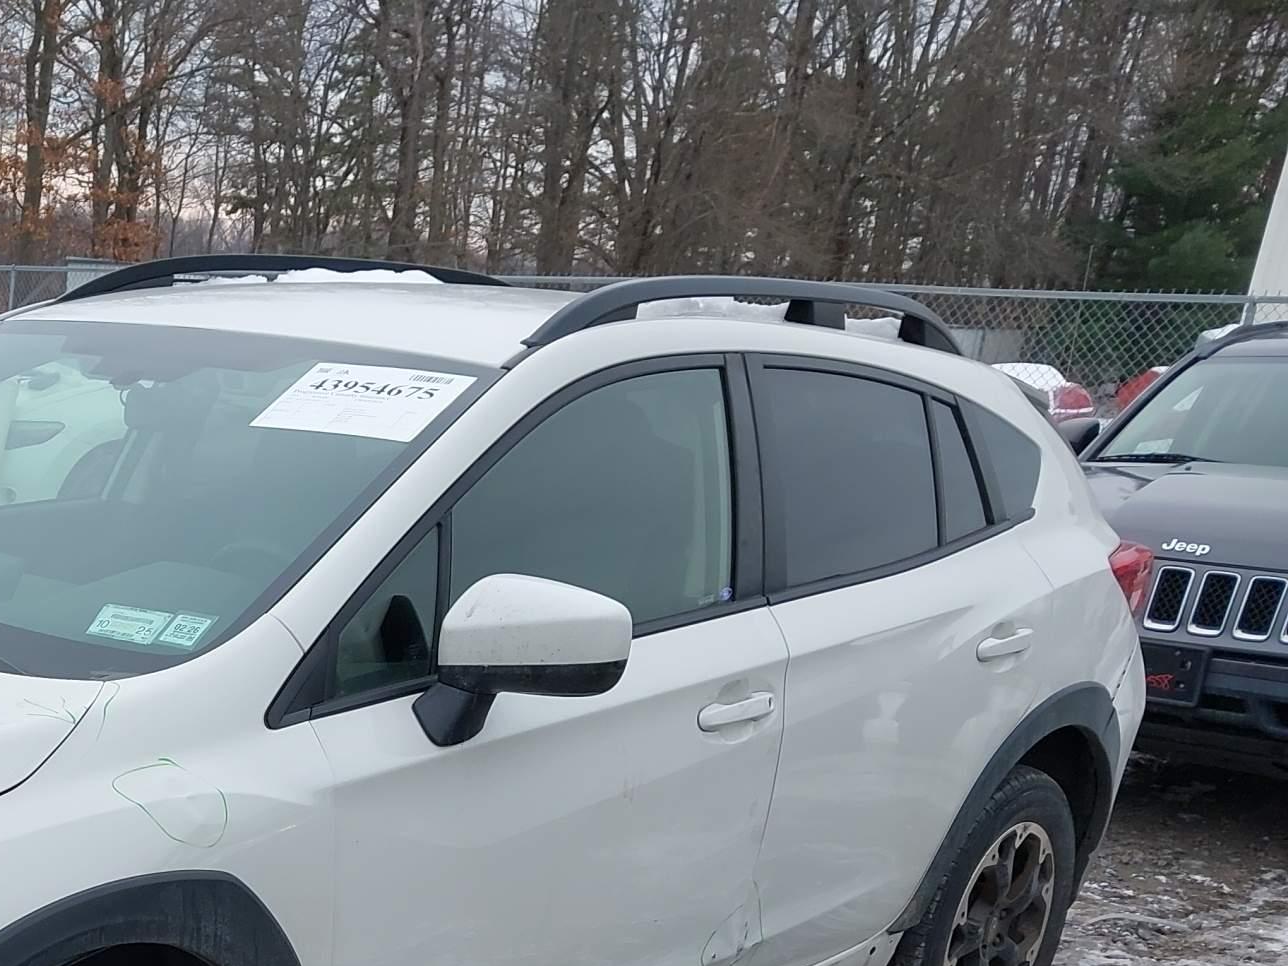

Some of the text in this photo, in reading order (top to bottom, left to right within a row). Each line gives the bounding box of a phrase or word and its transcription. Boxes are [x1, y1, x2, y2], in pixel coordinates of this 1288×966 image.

[309, 378, 440, 400] 43954675
[1162, 538, 1211, 556] Jeep
[96, 619, 111, 628] 10
[135, 625, 153, 636] 25
